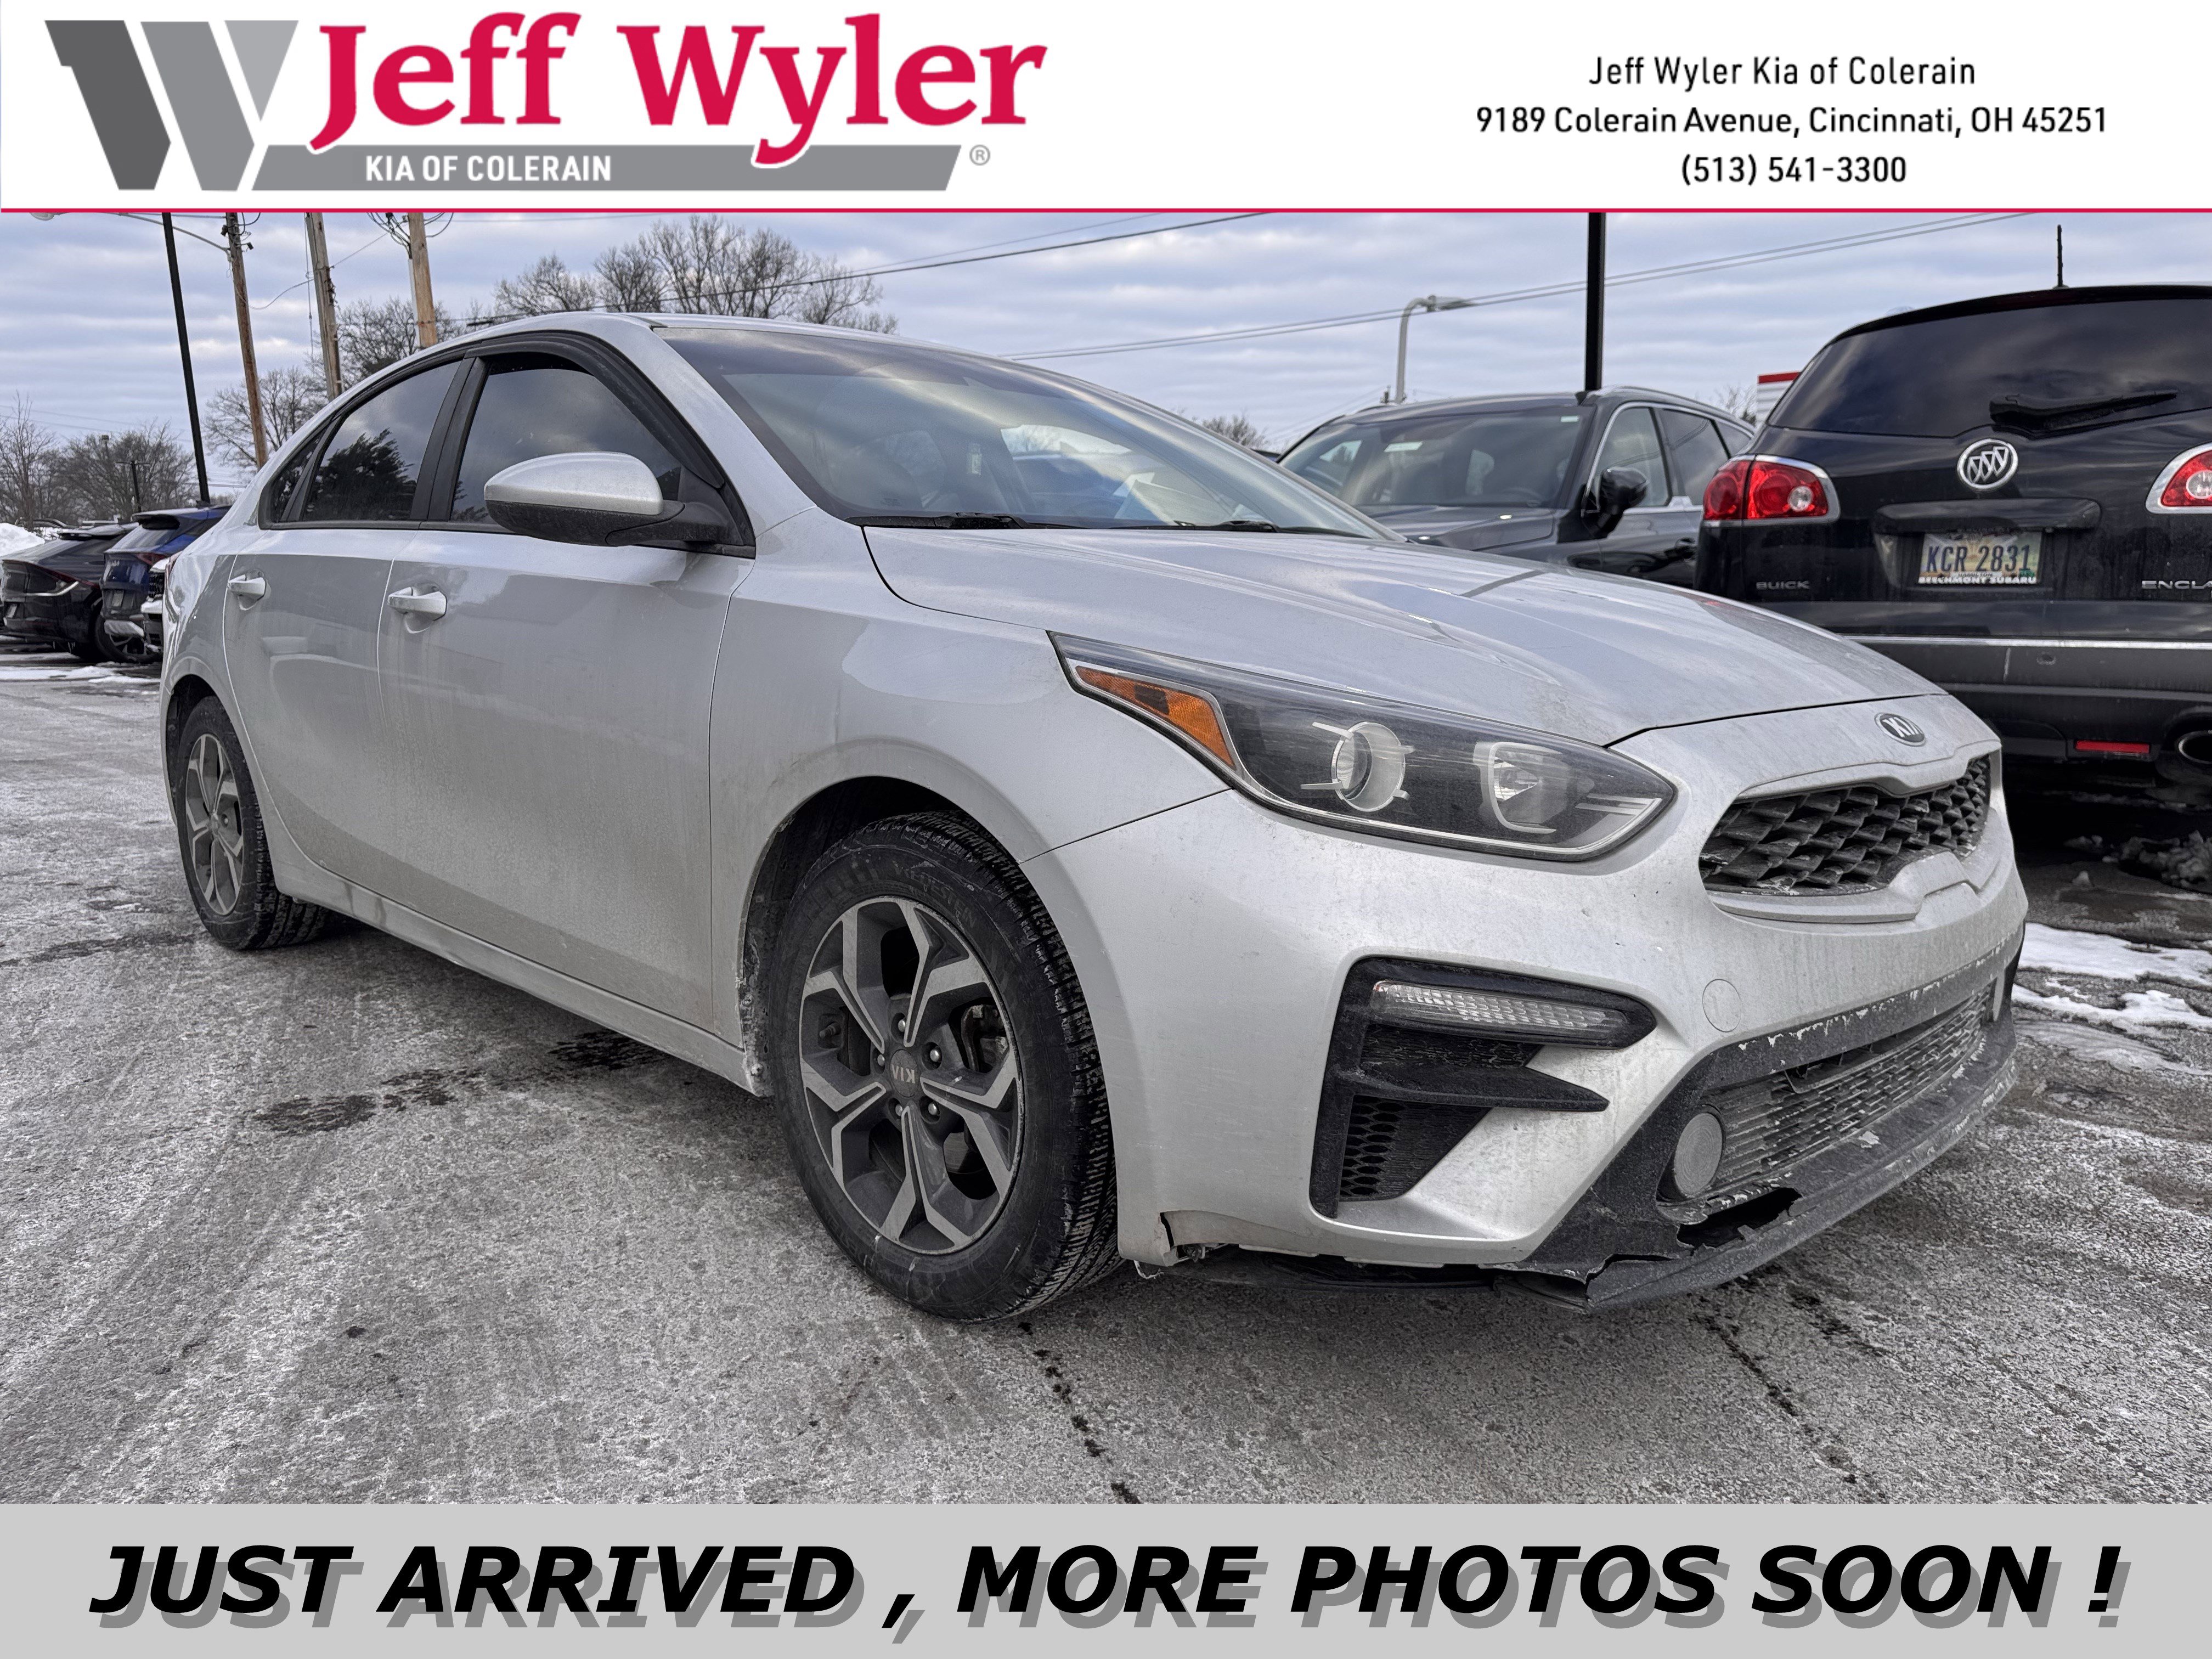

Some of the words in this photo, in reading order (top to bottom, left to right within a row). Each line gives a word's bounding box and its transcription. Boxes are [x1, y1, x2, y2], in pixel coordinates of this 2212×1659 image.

[1926, 545, 1968, 572] KCR
[1975, 544, 2031, 572] 2831
[1756, 580, 1810, 590] BUICK
[1989, 576, 2037, 584] SUBARU
